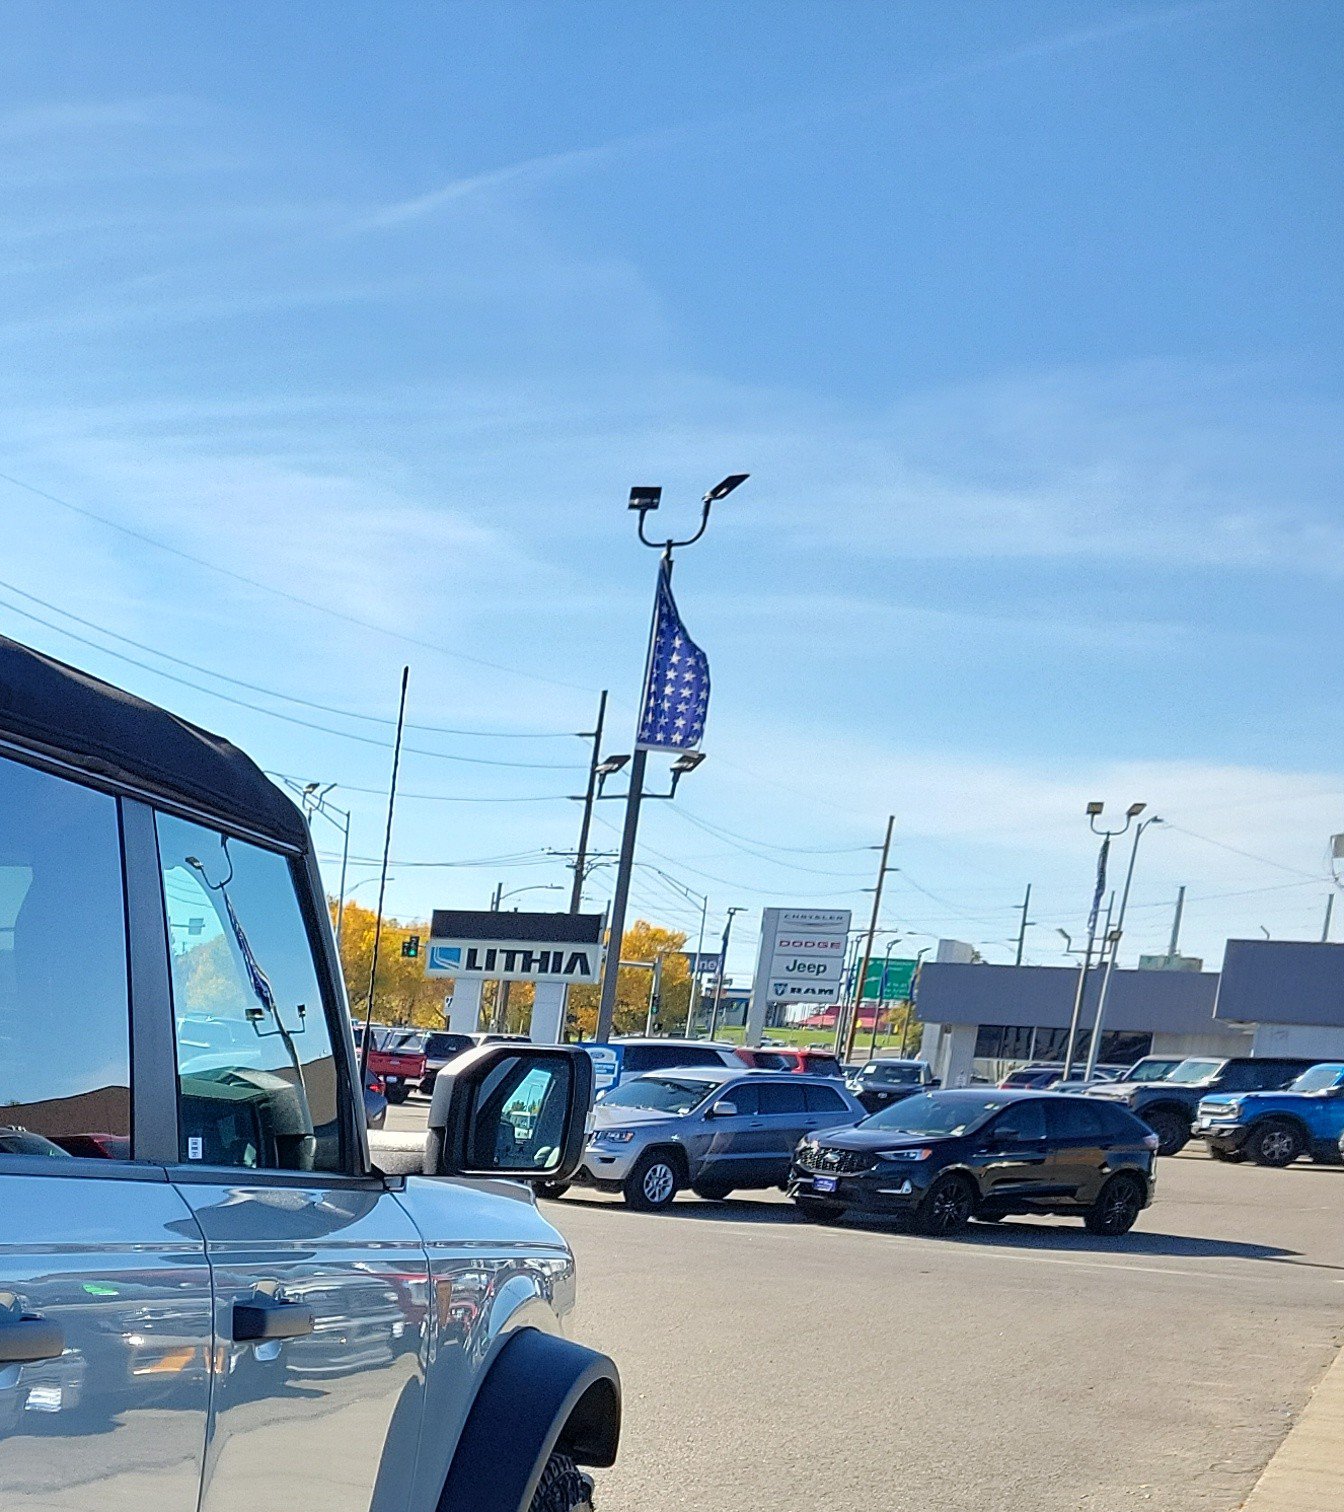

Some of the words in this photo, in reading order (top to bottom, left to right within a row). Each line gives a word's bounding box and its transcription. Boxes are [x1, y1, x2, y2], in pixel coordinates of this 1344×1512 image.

[779, 940, 841, 949] DODGE
[465, 948, 591, 976] LITHIA
[786, 959, 828, 976] Jeep
[790, 986, 834, 996] RAM
